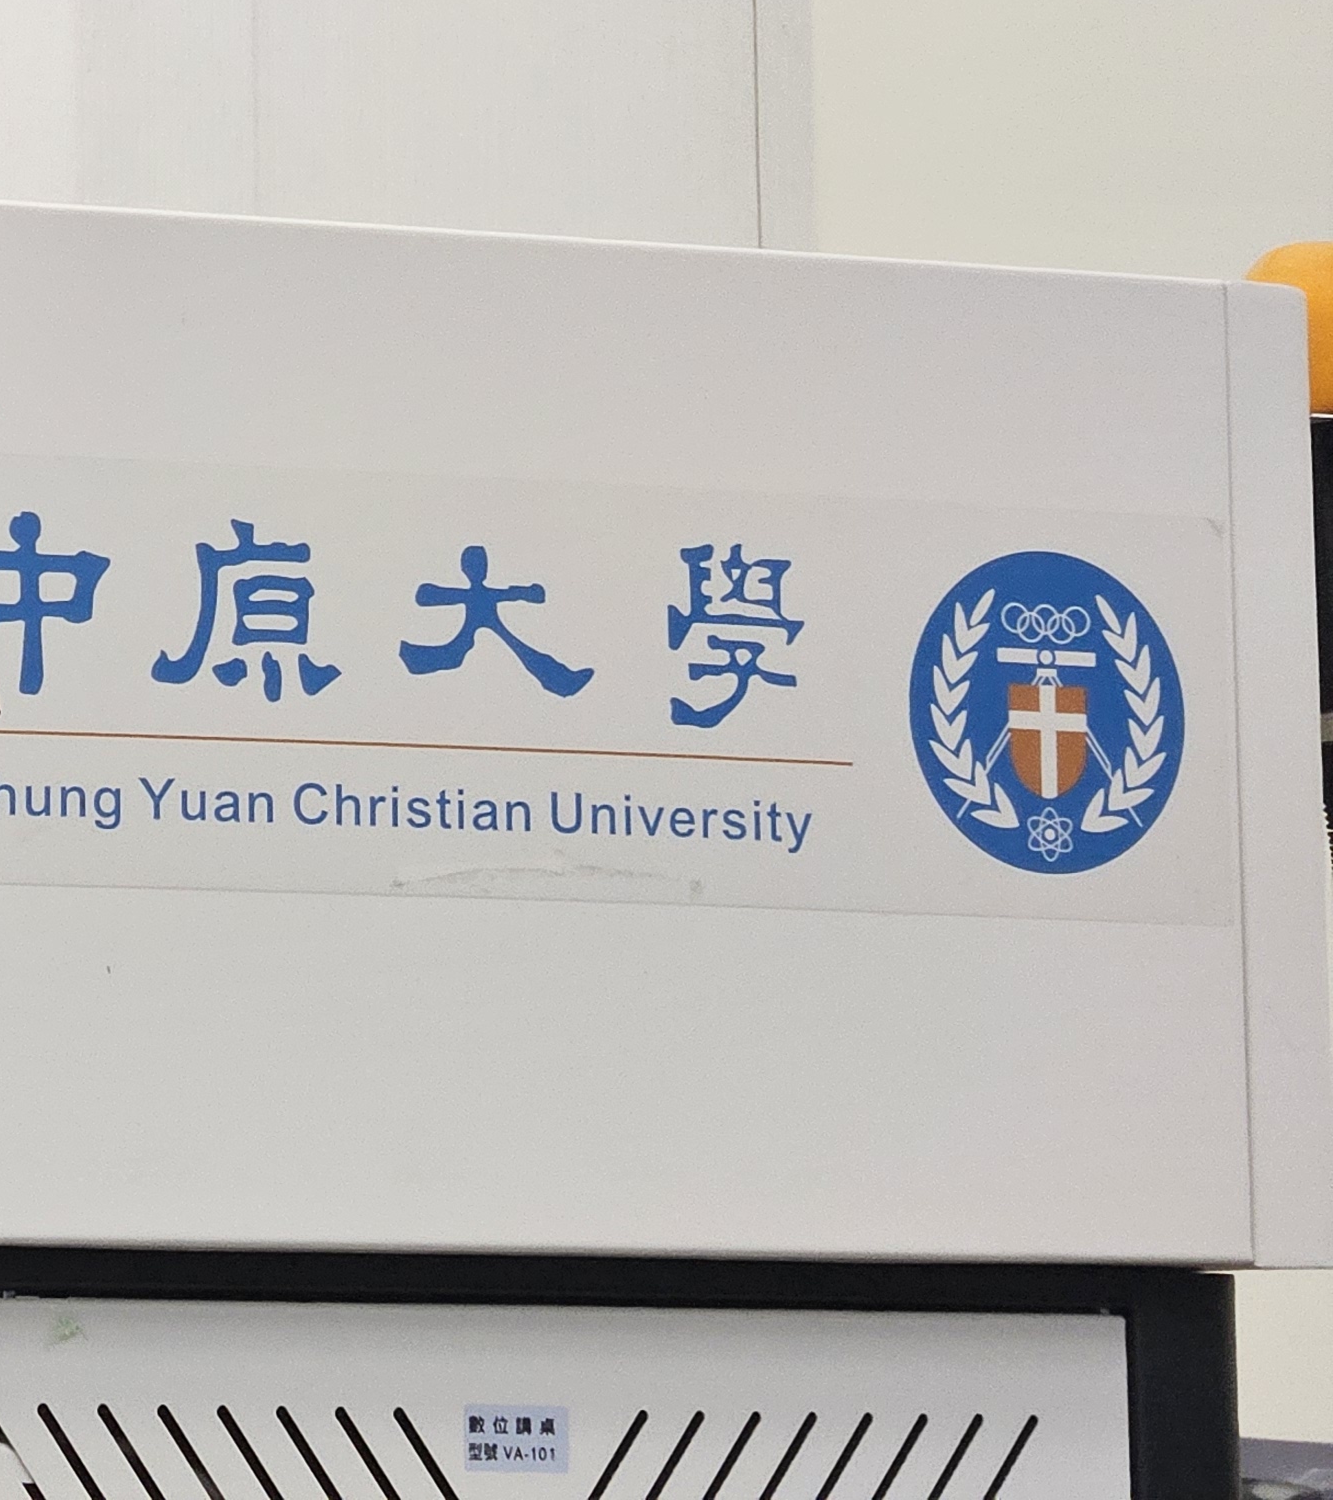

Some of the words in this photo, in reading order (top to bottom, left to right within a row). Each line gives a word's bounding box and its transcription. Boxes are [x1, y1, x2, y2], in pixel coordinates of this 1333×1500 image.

[138, 777, 275, 825] Yuan
[292, 782, 531, 833] Christian
[550, 792, 812, 854] University
[503, 1446, 555, 1462] VA-101
